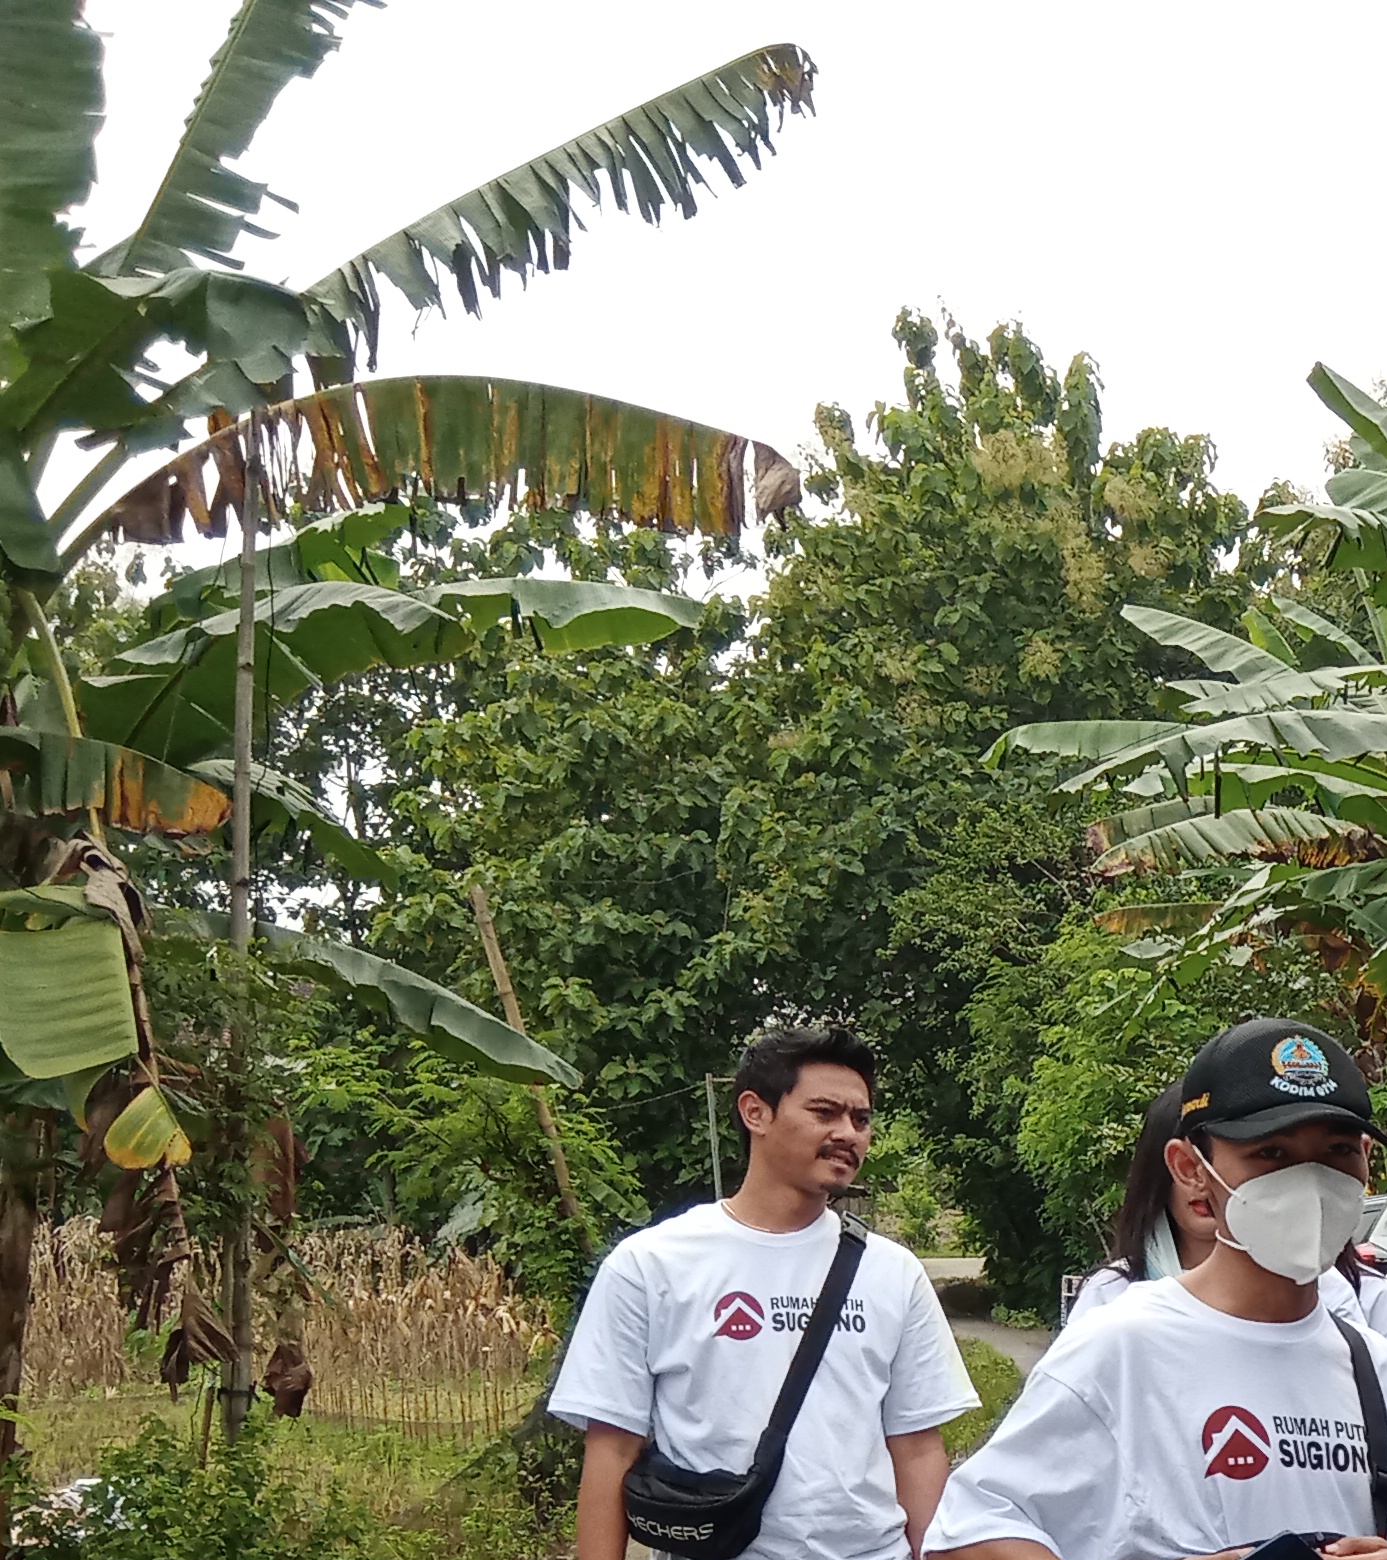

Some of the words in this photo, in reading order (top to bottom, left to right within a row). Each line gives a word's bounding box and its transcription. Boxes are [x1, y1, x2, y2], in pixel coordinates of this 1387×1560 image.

[1269, 1076, 1316, 1097] KODIM
[771, 1311, 866, 1333] SUGNO
[1272, 1415, 1331, 1438] RUMAH
[1278, 1438, 1368, 1474] SUGION
